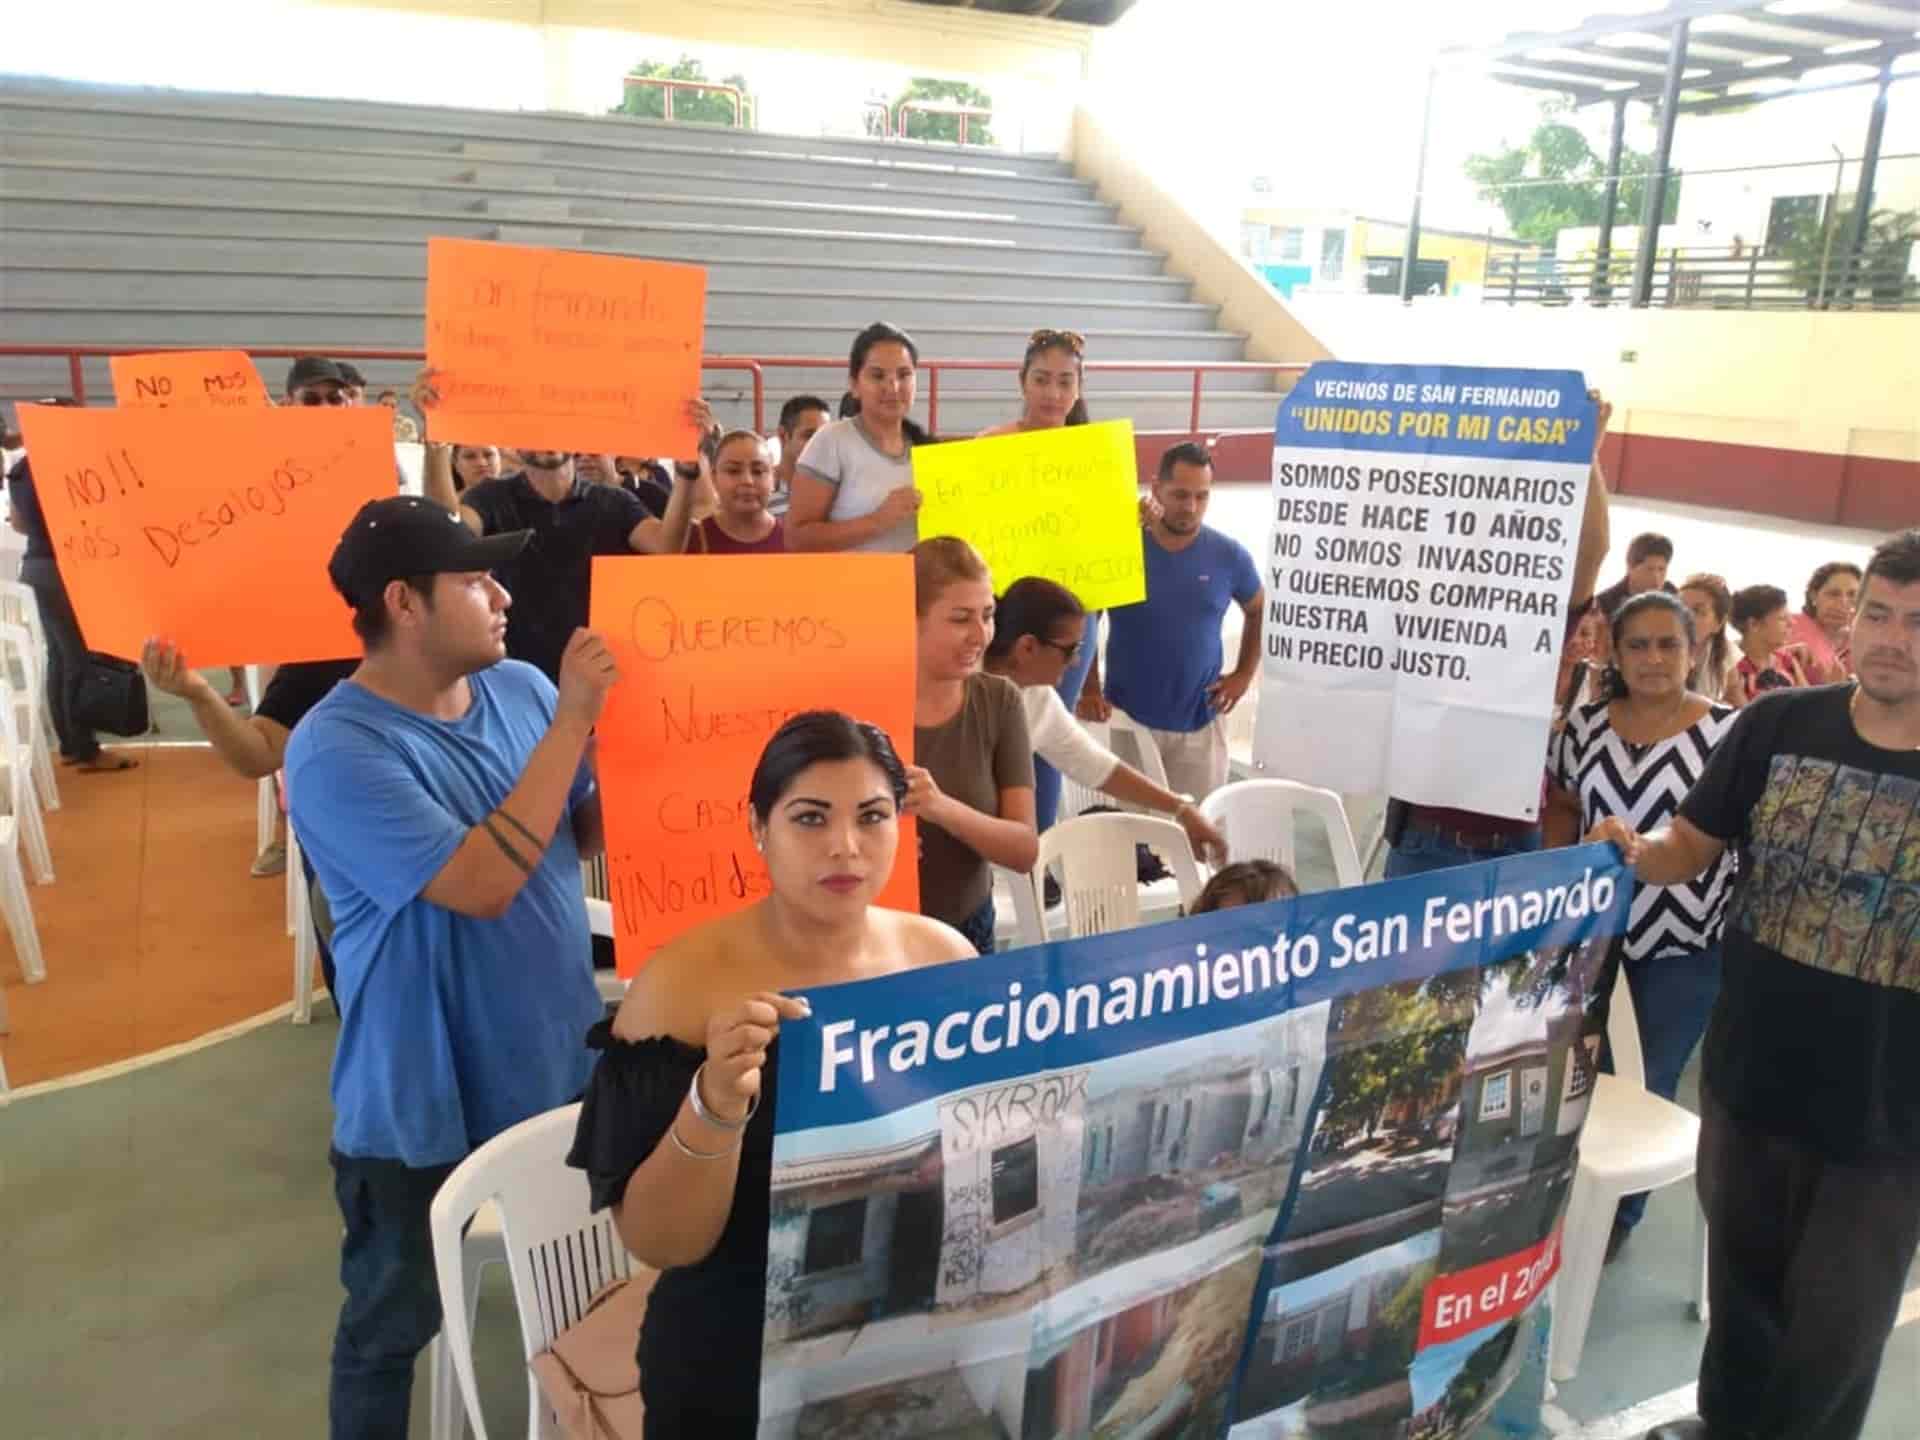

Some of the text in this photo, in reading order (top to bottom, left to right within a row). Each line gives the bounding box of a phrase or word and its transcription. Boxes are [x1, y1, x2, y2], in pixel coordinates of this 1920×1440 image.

[135, 376, 172, 399] NO
[1314, 380, 1560, 409] VECINOS DE SAN FERNANDO
[1398, 412, 1449, 438] POR
[1456, 415, 1490, 440] MI
[1280, 463, 1576, 506] SOMOS POSESIONARIOS
[1278, 498, 1568, 548] DESDE HACE 10 AÑOS,
[1274, 533, 1564, 580] NO SOMOS INVASORES
[1271, 567, 1558, 617] Y QUEREMOS COMPRAR
[1269, 602, 1552, 654] NUESTRA VIVIENDA A
[1268, 633, 1471, 682] UN PRECIO JUSTO.
[728, 850, 769, 899] de
[819, 866, 1614, 1092] Fraccionamiento San Fernando
[1434, 1293, 1472, 1329] En
[1480, 1271, 1509, 1312] el
